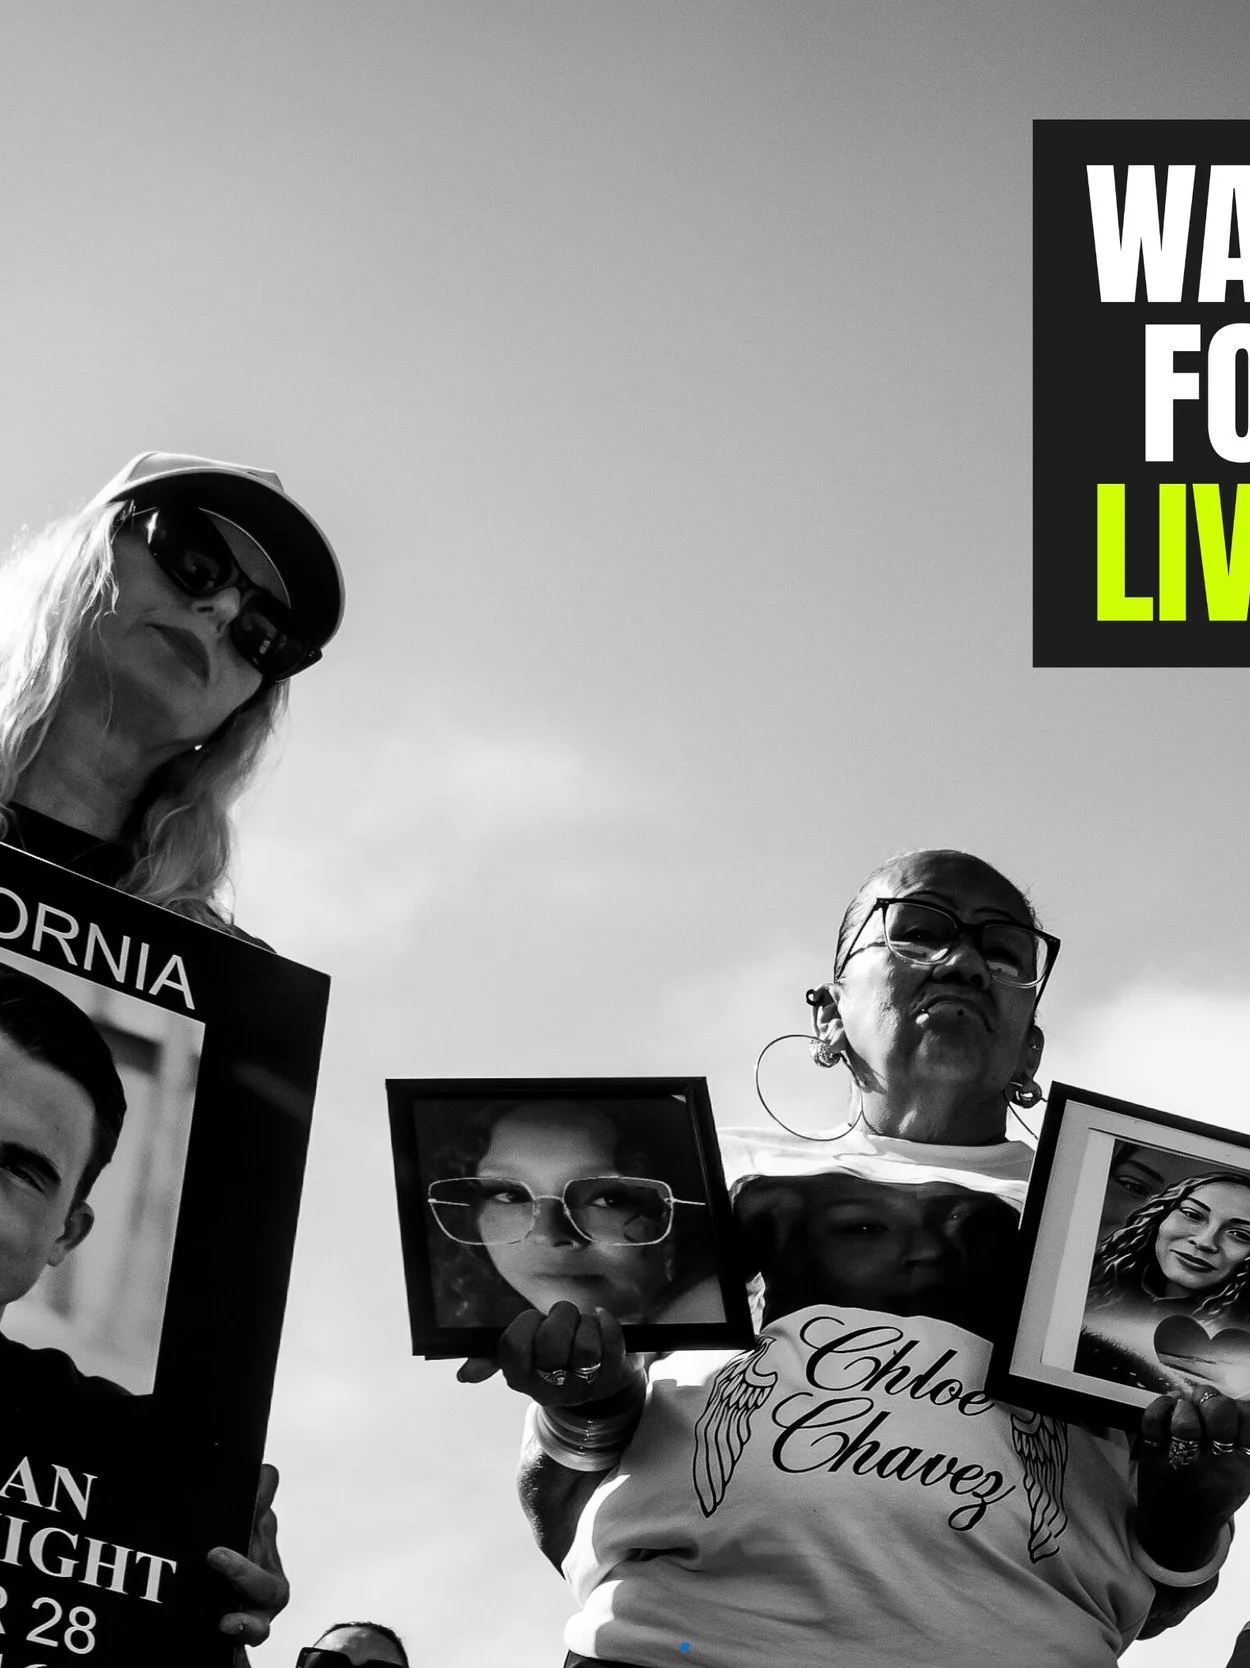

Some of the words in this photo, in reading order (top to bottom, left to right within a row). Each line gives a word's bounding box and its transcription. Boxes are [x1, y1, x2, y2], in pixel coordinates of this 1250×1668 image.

[800, 1315, 998, 1417] Chloe
[772, 1391, 1016, 1532] Chavez
[0, 1513, 177, 1603] IGHT
[26, 1597, 97, 1655] 28
